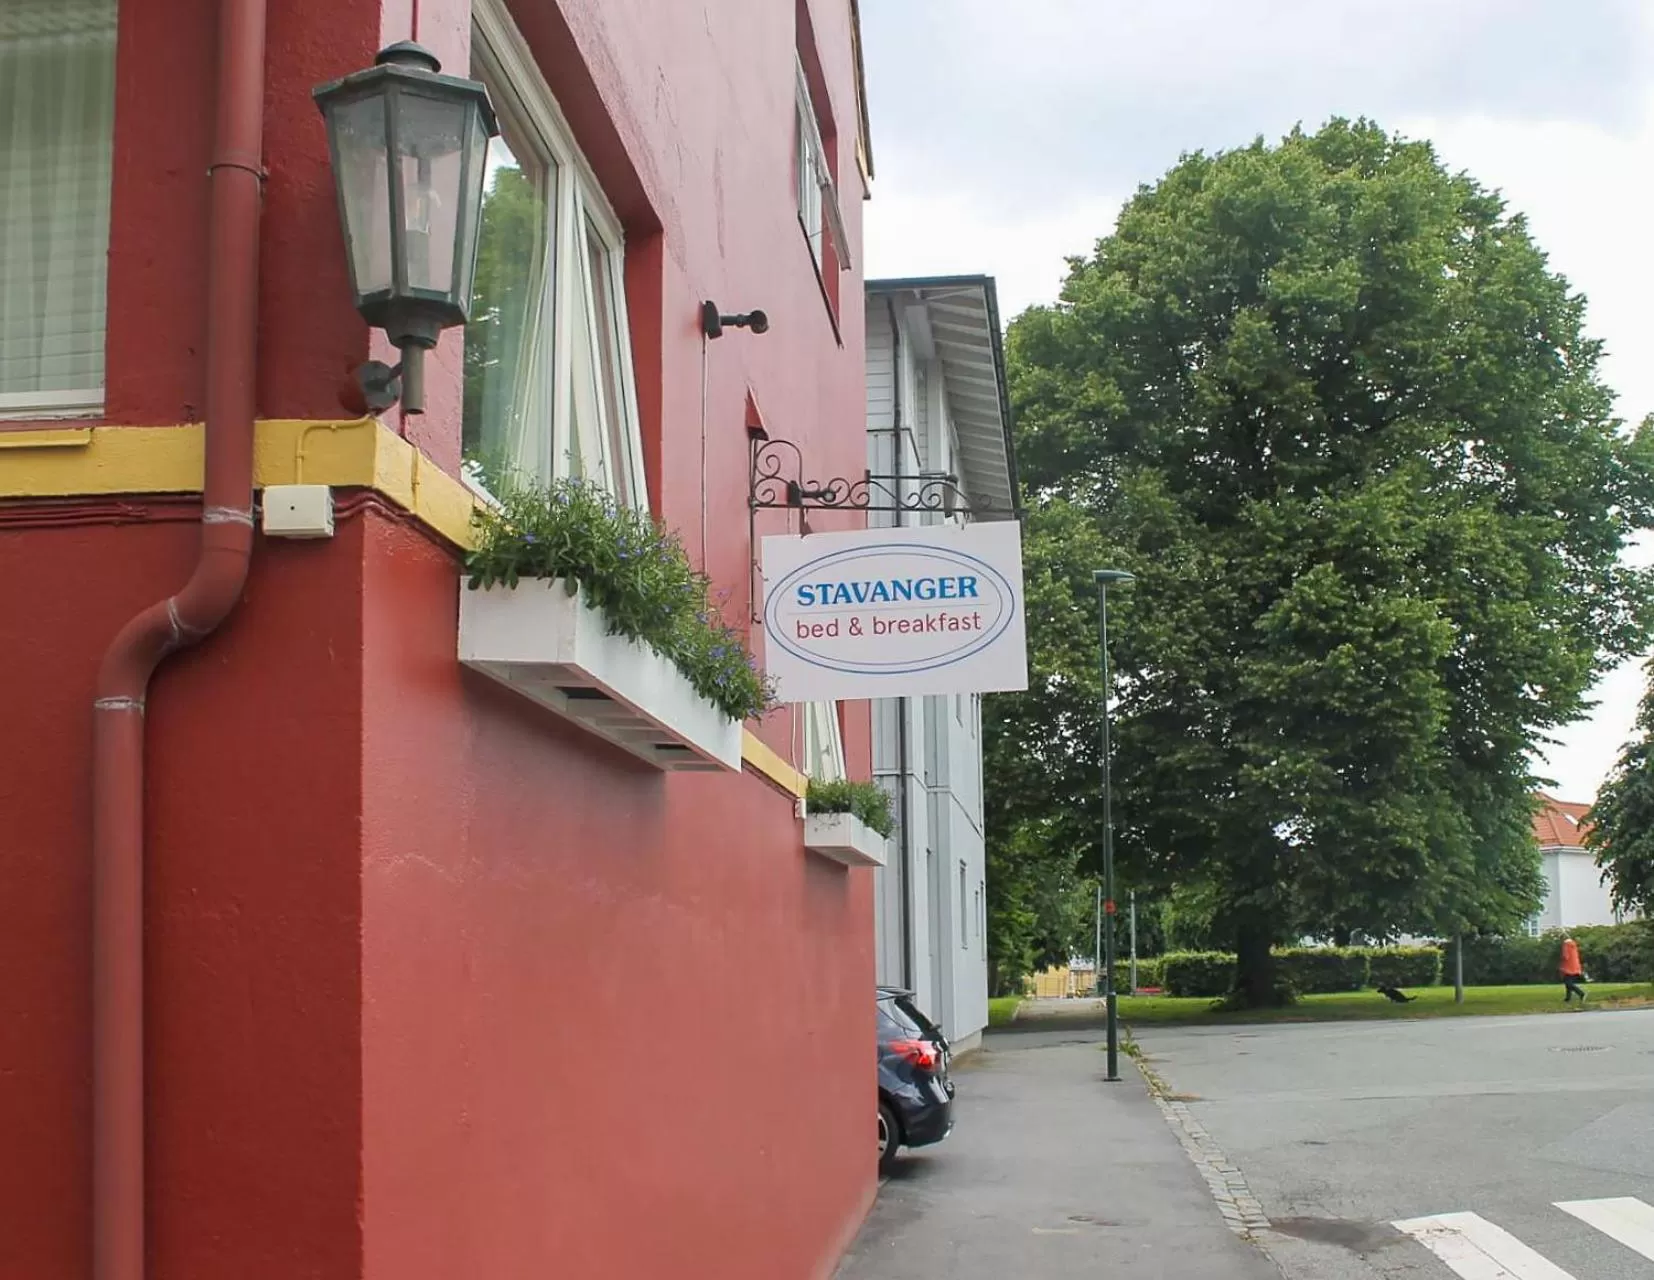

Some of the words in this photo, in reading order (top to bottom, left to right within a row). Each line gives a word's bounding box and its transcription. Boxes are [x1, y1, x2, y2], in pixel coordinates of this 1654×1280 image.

[797, 576, 979, 606] STAVANGER
[796, 617, 839, 639] bed
[849, 617, 864, 636] &
[873, 611, 982, 635] breakfast
